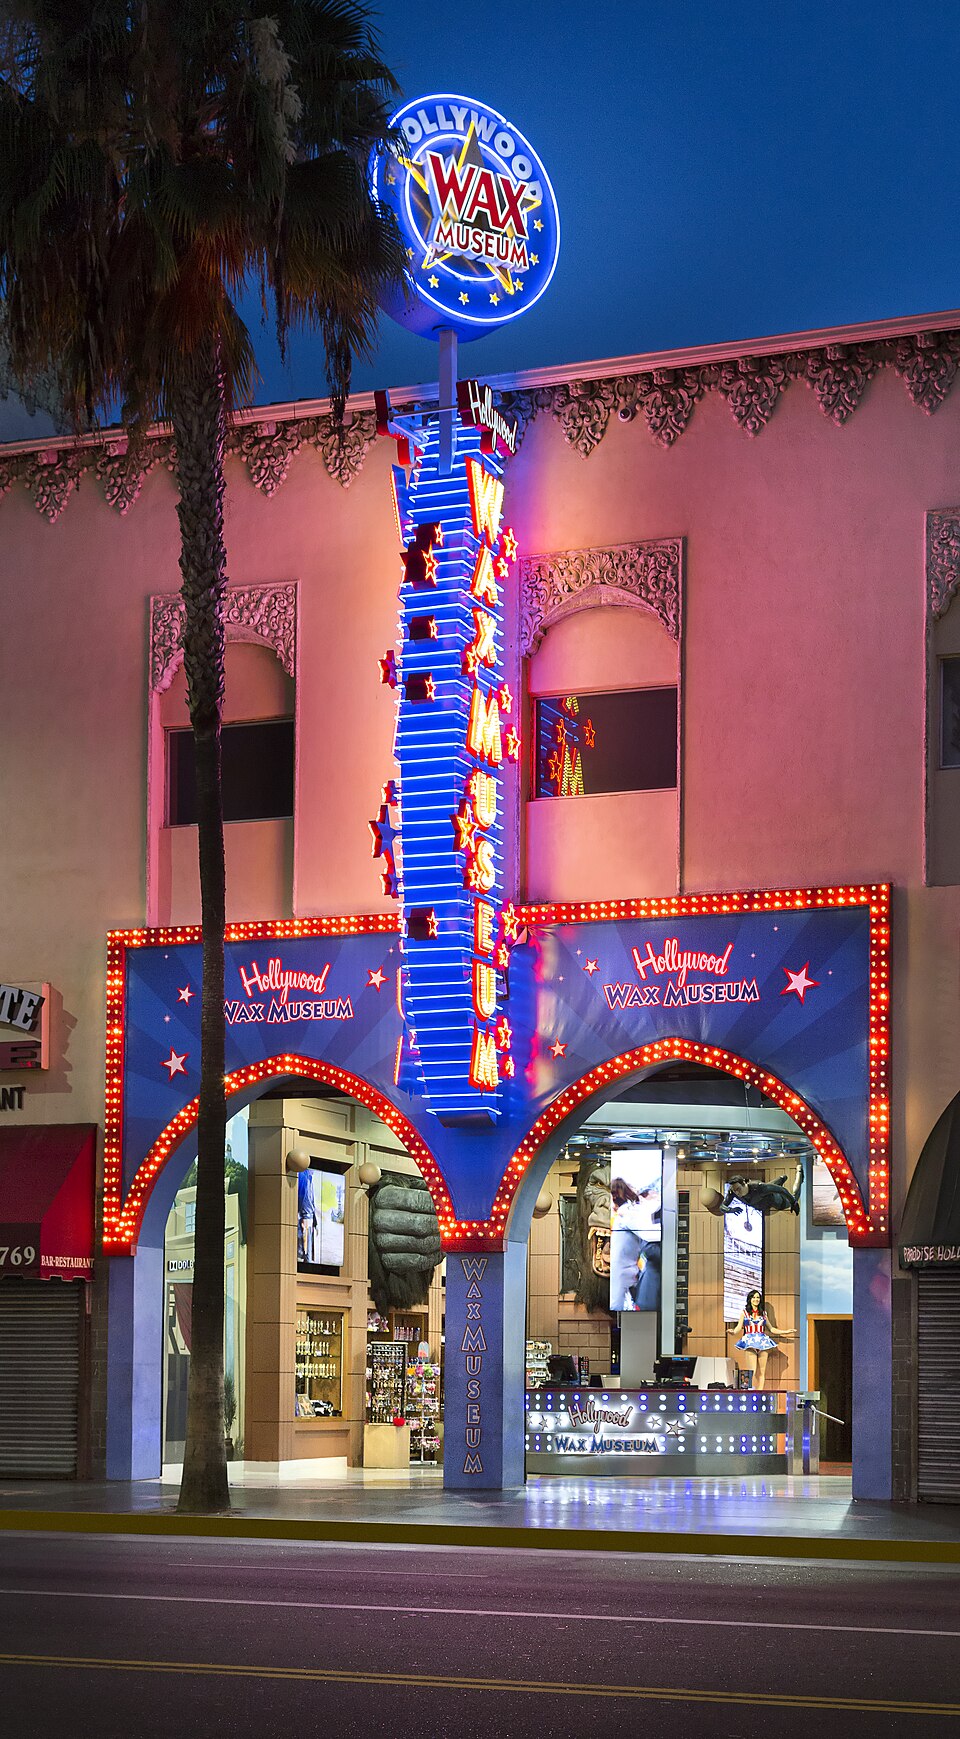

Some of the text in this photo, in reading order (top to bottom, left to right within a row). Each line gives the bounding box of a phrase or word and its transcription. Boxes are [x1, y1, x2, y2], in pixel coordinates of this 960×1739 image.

[426, 150, 530, 240] WAX
[433, 218, 530, 270] MUSEUM
[464, 379, 518, 456] Hollywood
[464, 455, 505, 1094] WAX MUSEUM
[239, 957, 331, 1005] Hollywood
[631, 937, 735, 988] Hollywood
[266, 995, 354, 1024] MUSEUM
[603, 976, 761, 1010] WAX MUSEUM
[461, 1257, 488, 1474] WAX MUSEUM
[568, 1400, 634, 1434] Hollywood
[554, 1434, 660, 1454] WAX MUSEUM
